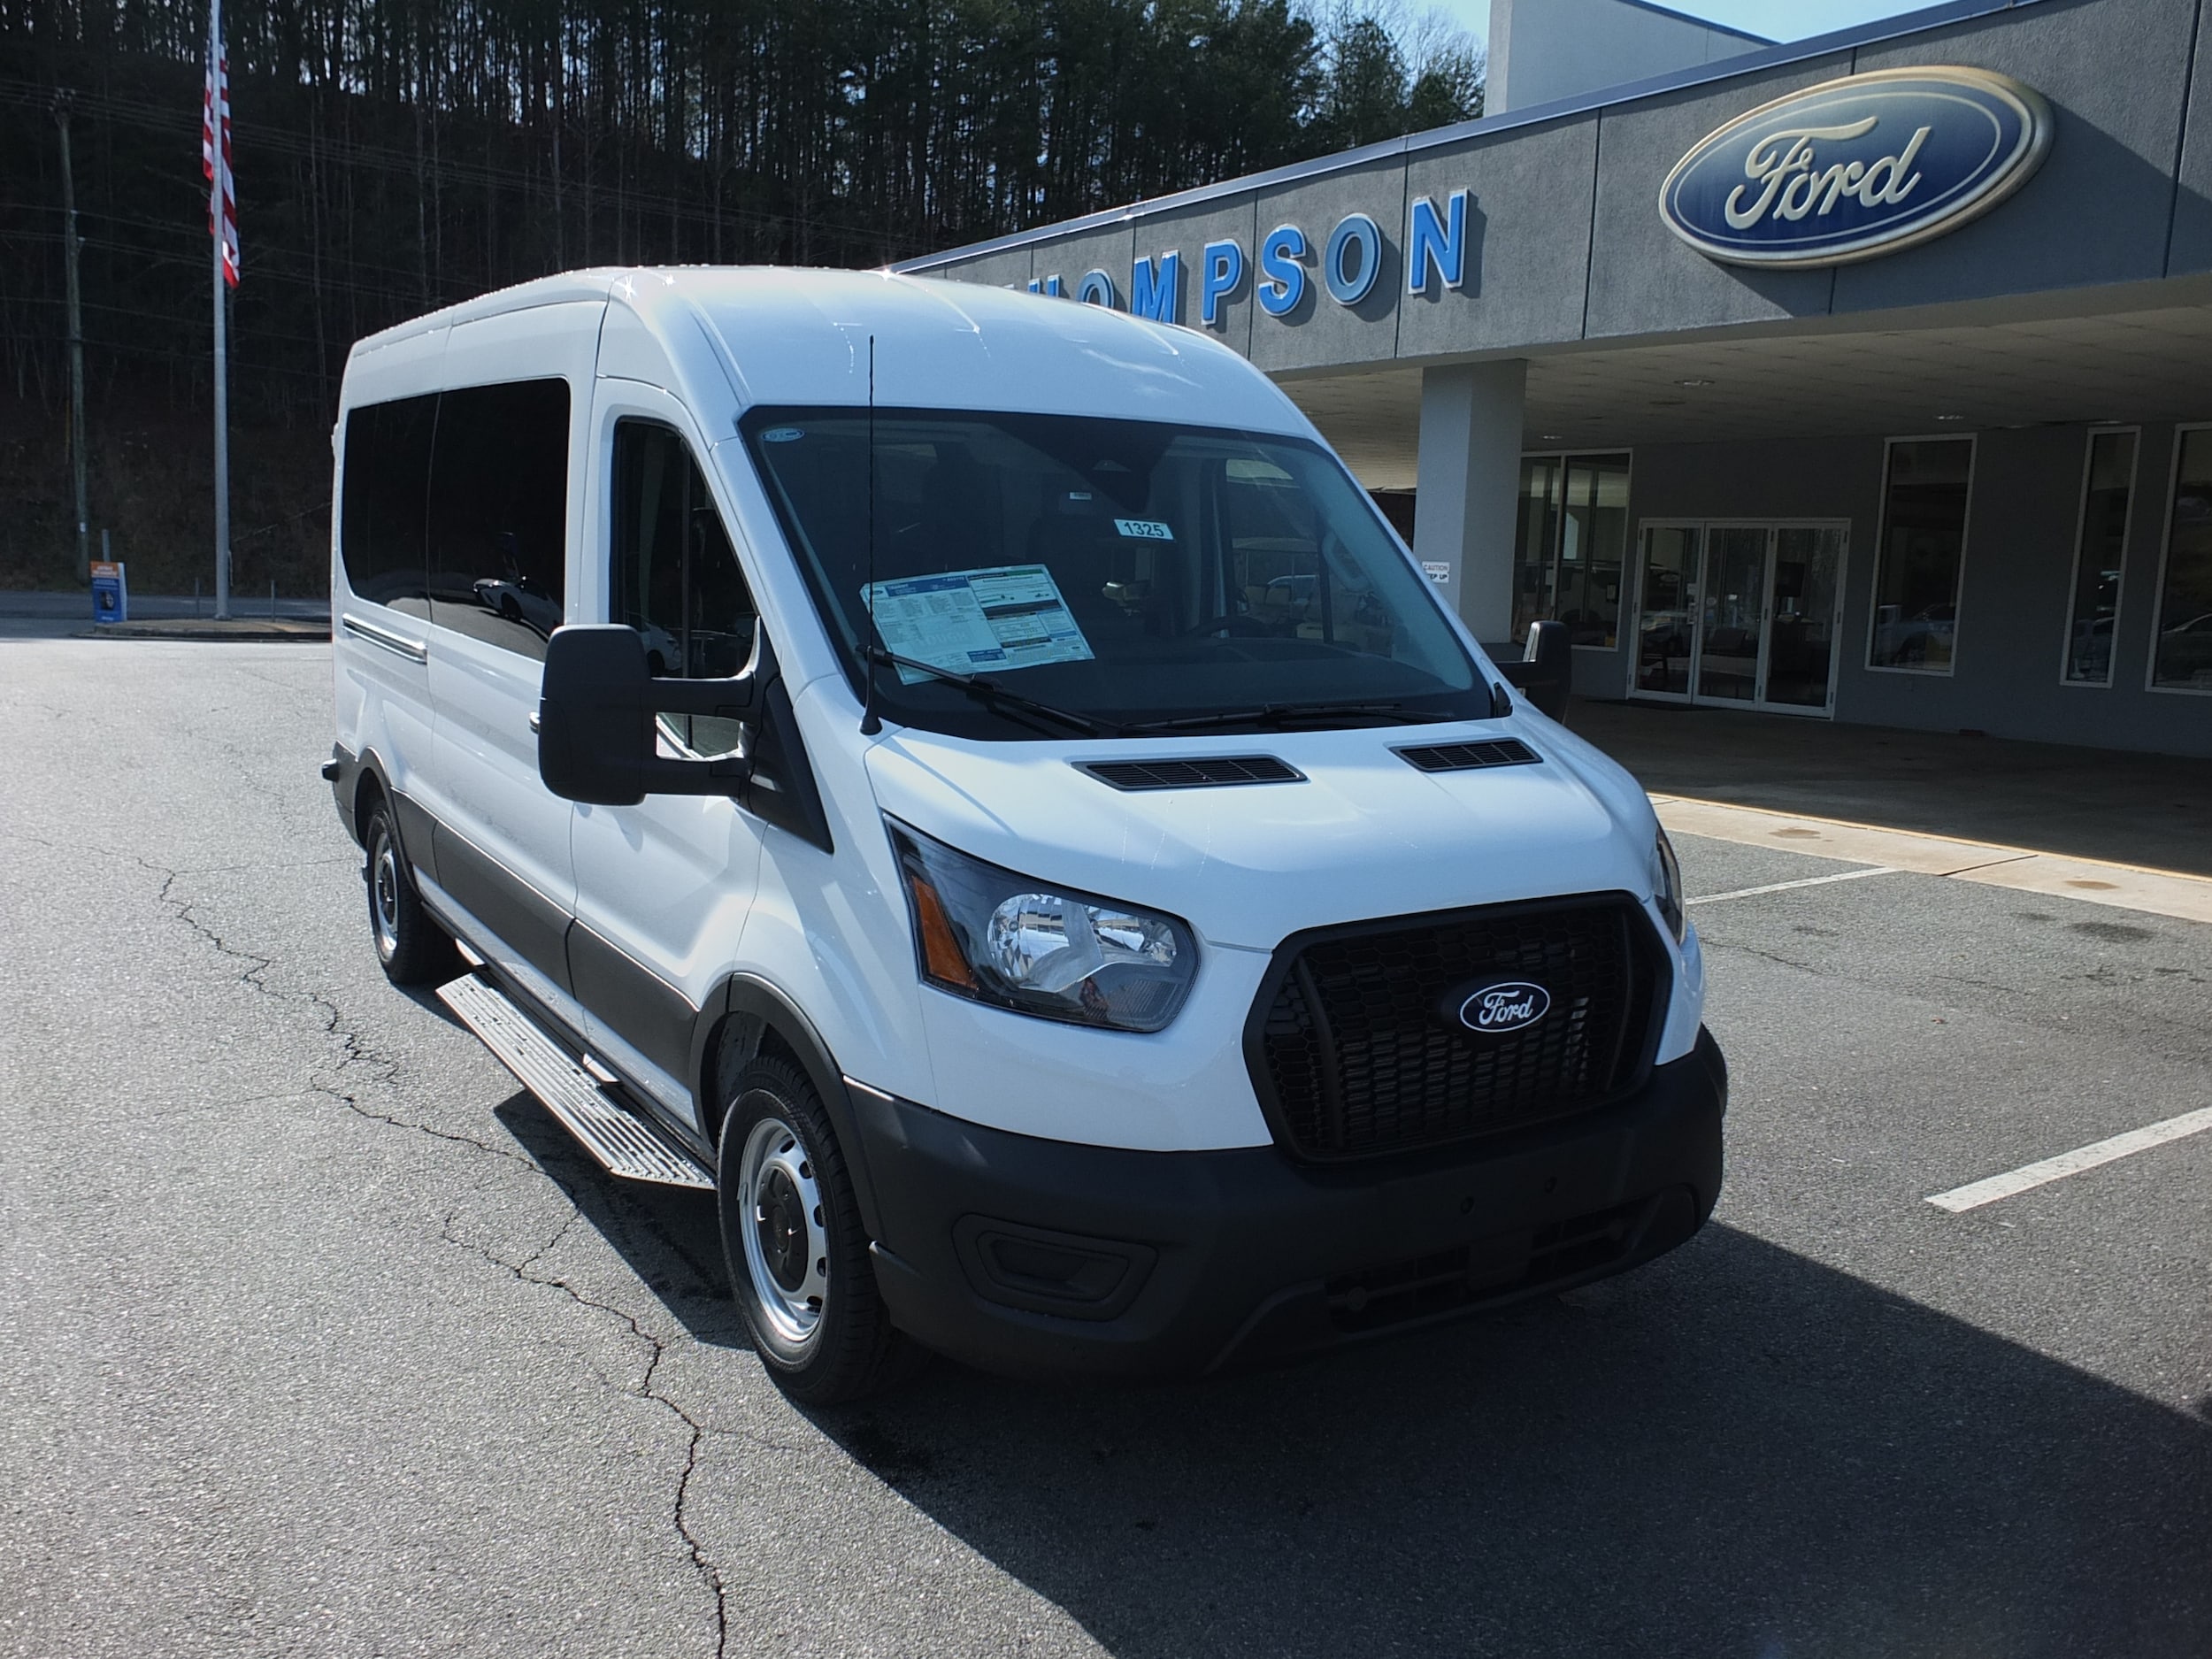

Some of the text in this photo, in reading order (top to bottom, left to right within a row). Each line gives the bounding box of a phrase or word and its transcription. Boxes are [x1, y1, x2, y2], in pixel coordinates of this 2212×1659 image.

[1724, 115, 1932, 231] Ford
[1002, 186, 1470, 326] OMPSON
[1124, 521, 1164, 537] 1325
[1479, 990, 1534, 1025] Ford
